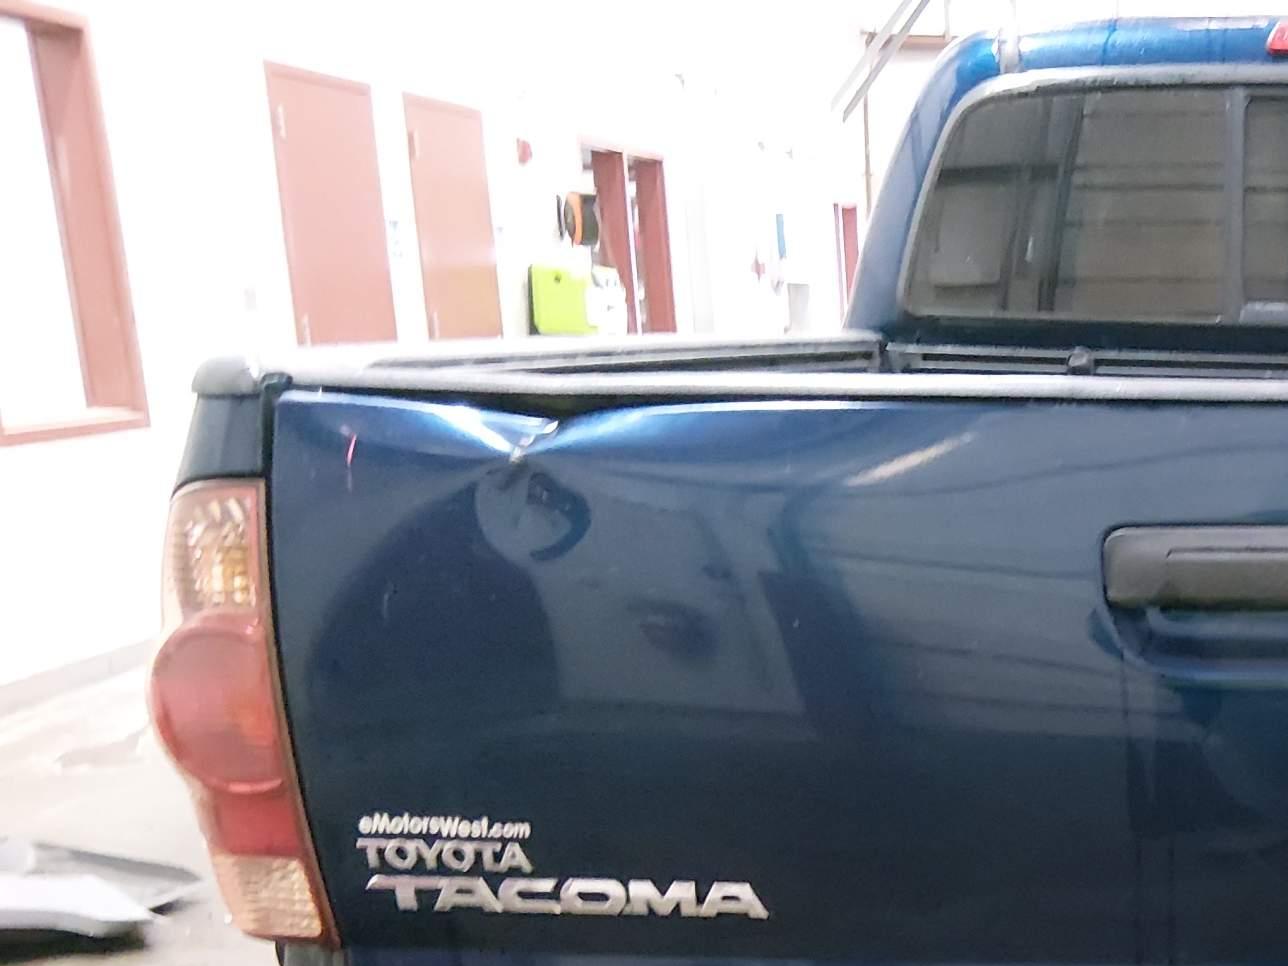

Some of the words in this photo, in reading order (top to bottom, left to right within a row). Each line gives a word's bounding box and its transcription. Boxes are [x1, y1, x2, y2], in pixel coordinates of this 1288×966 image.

[357, 812, 532, 838] eMotorsWest.com
[356, 837, 534, 873] TOYOTA
[366, 874, 770, 919] TACOMA
